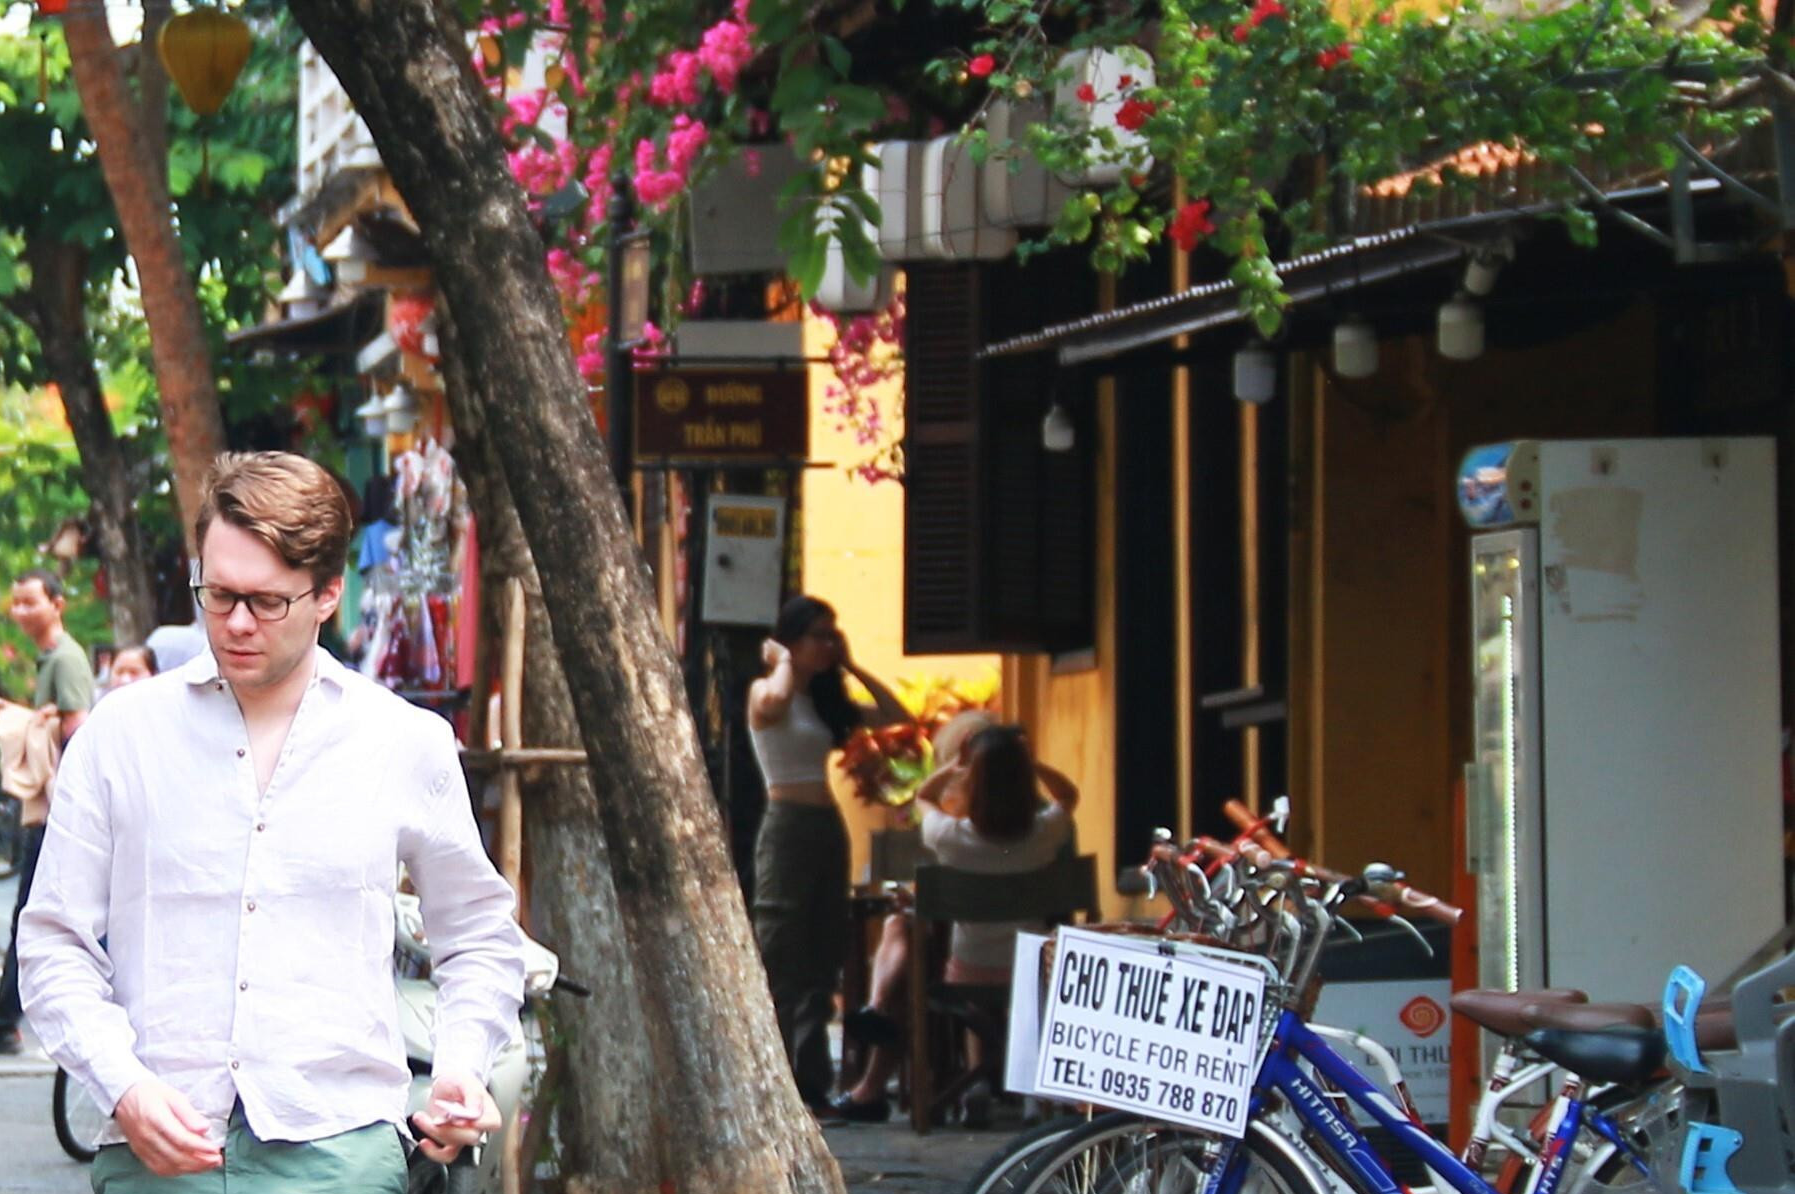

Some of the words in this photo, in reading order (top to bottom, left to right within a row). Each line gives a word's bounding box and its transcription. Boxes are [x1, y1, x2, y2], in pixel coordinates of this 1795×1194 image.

[1059, 950, 1110, 1011] CHO
[1114, 960, 1174, 1026] THUÊ
[1175, 976, 1210, 1035] XE
[1211, 984, 1256, 1056] ĐẠP
[1051, 1020, 1141, 1063] BICYCLE
[1146, 1041, 1189, 1074] FOR
[1195, 1053, 1249, 1088] RENT
[1052, 1056, 1095, 1089] TEL:
[1100, 1067, 1151, 1102] 0935
[1157, 1080, 1196, 1112] 788
[1201, 1090, 1238, 1123] 870
[1291, 1078, 1358, 1149] HITASA
